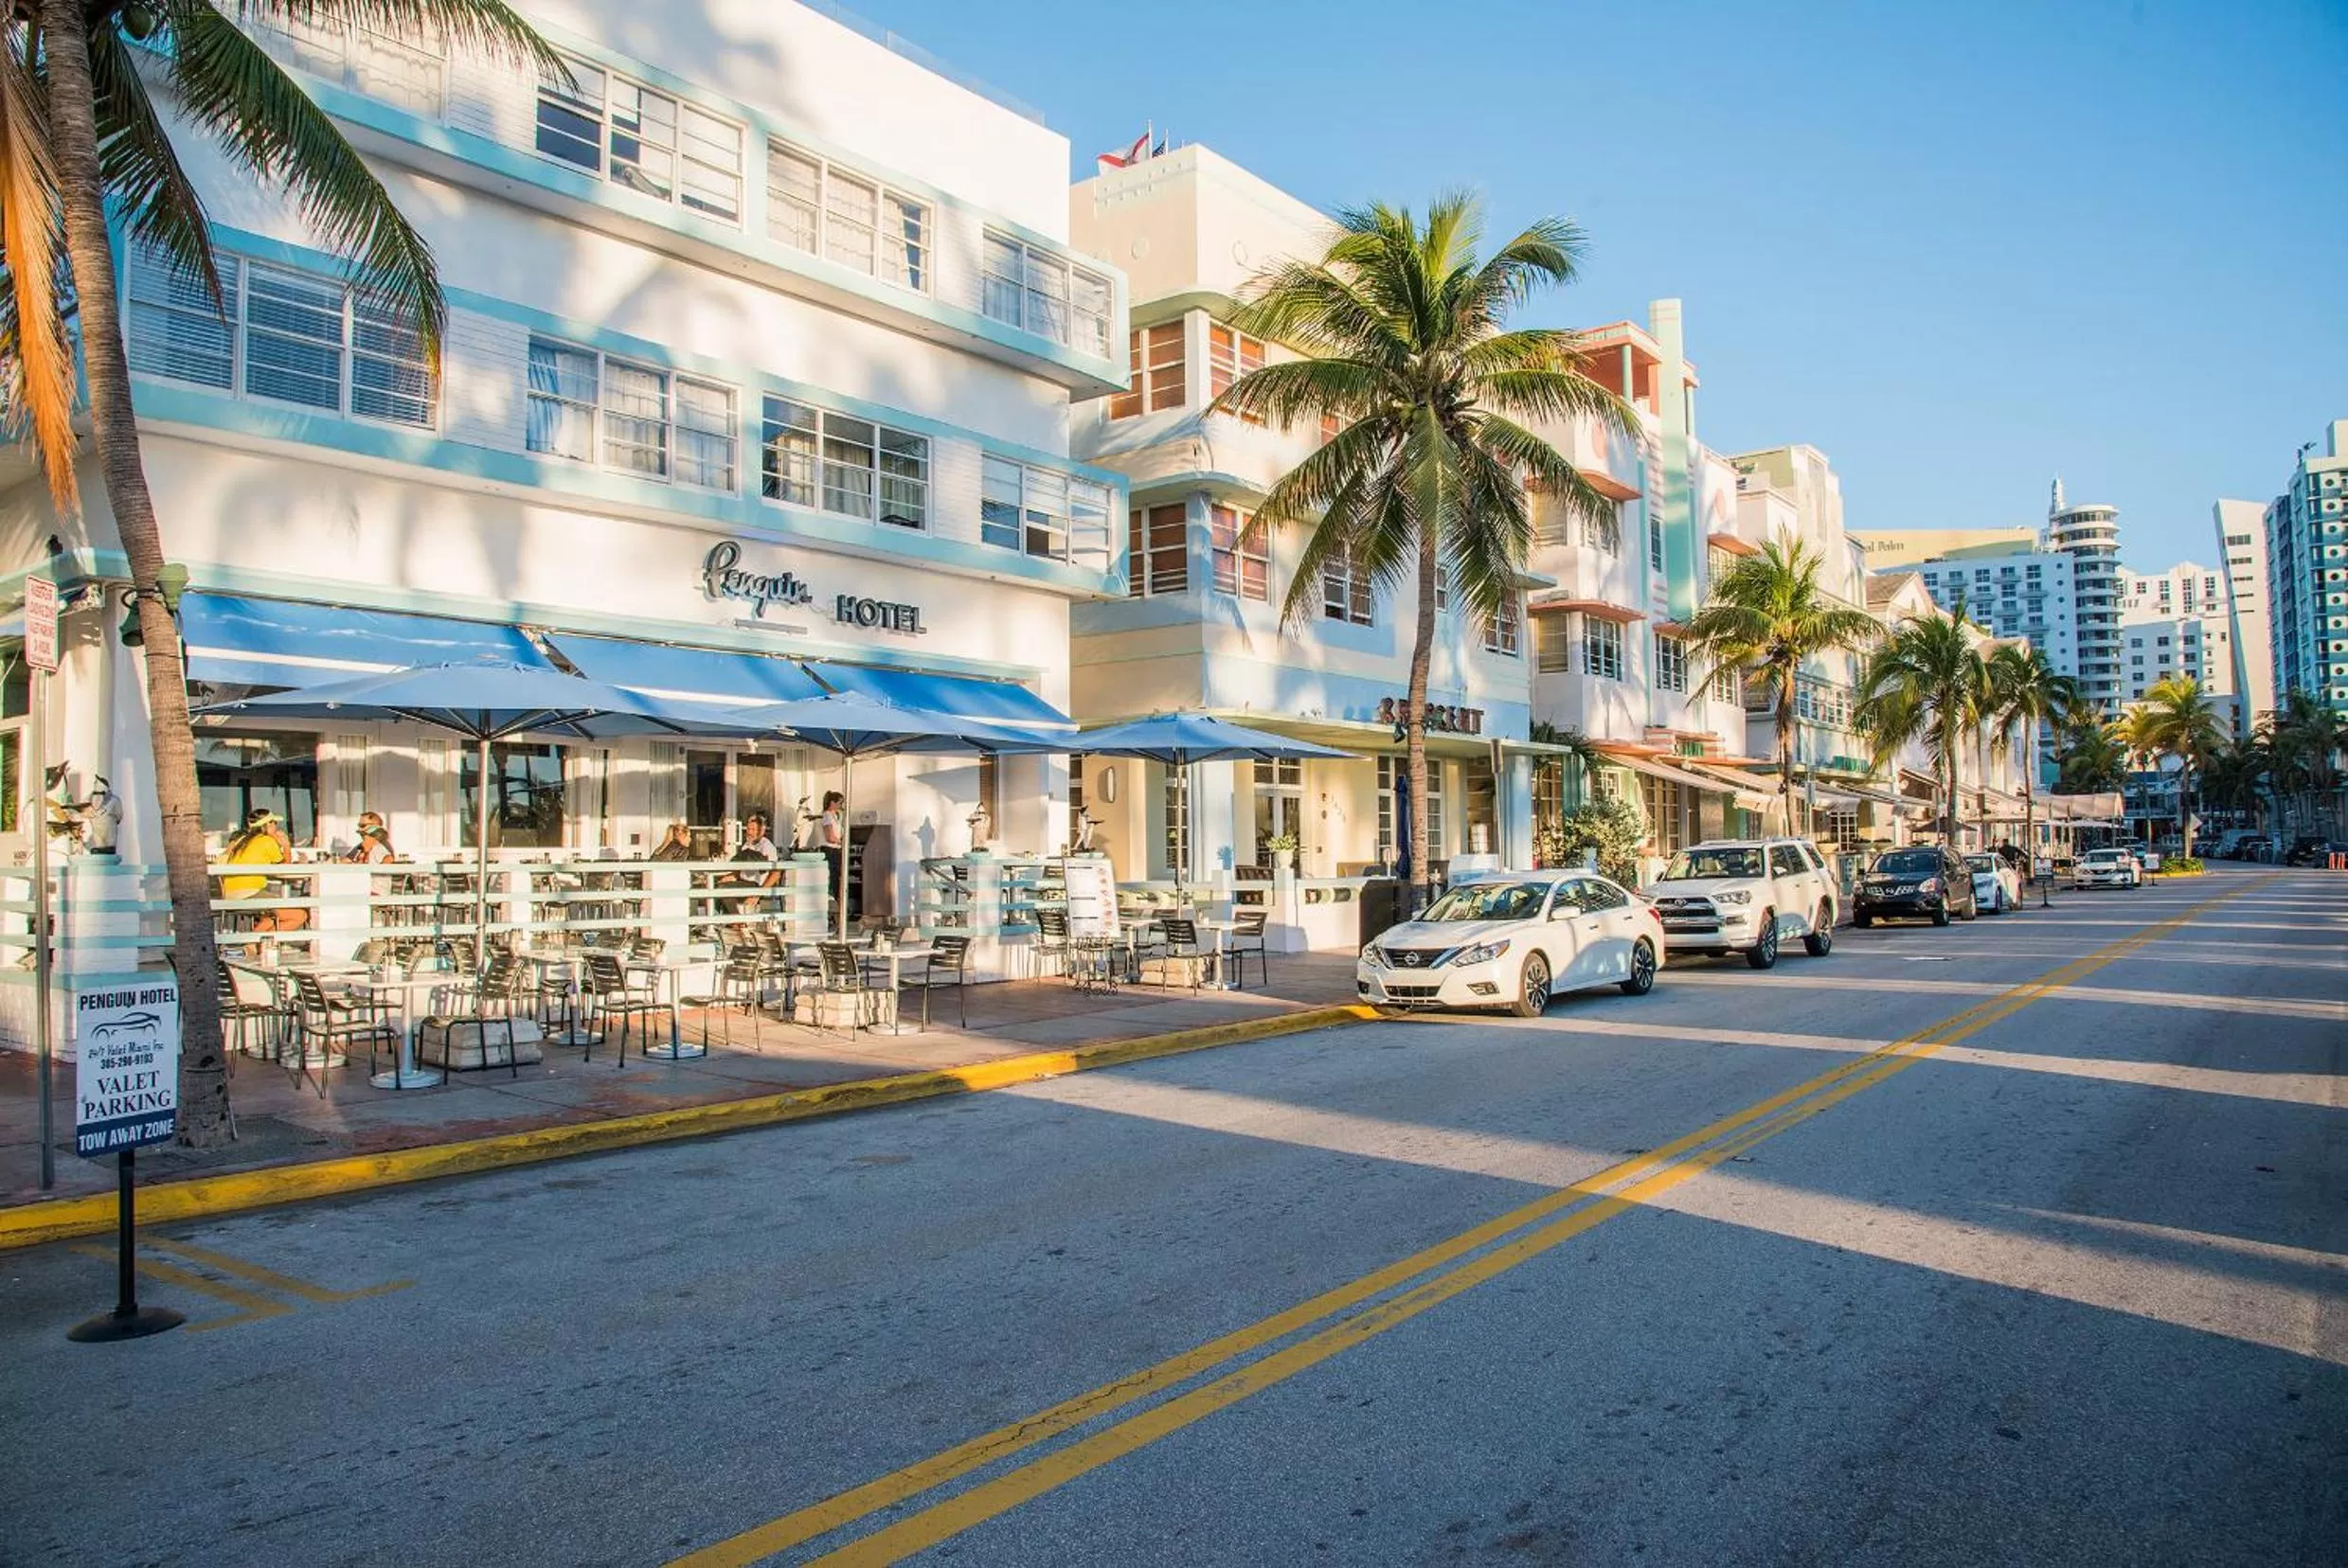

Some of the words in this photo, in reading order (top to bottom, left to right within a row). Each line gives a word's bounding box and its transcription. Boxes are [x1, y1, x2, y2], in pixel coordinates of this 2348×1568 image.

[703, 541, 813, 618] Penguin
[836, 594, 927, 634] HOTEL
[80, 991, 136, 1011] PENGUIN
[140, 989, 177, 1005] HOTEL
[98, 1070, 160, 1095] VALET
[84, 1090, 170, 1119] PARKING
[79, 1131, 106, 1151] TOW
[109, 1124, 144, 1146] AWAY
[145, 1118, 174, 1139] ZONE
